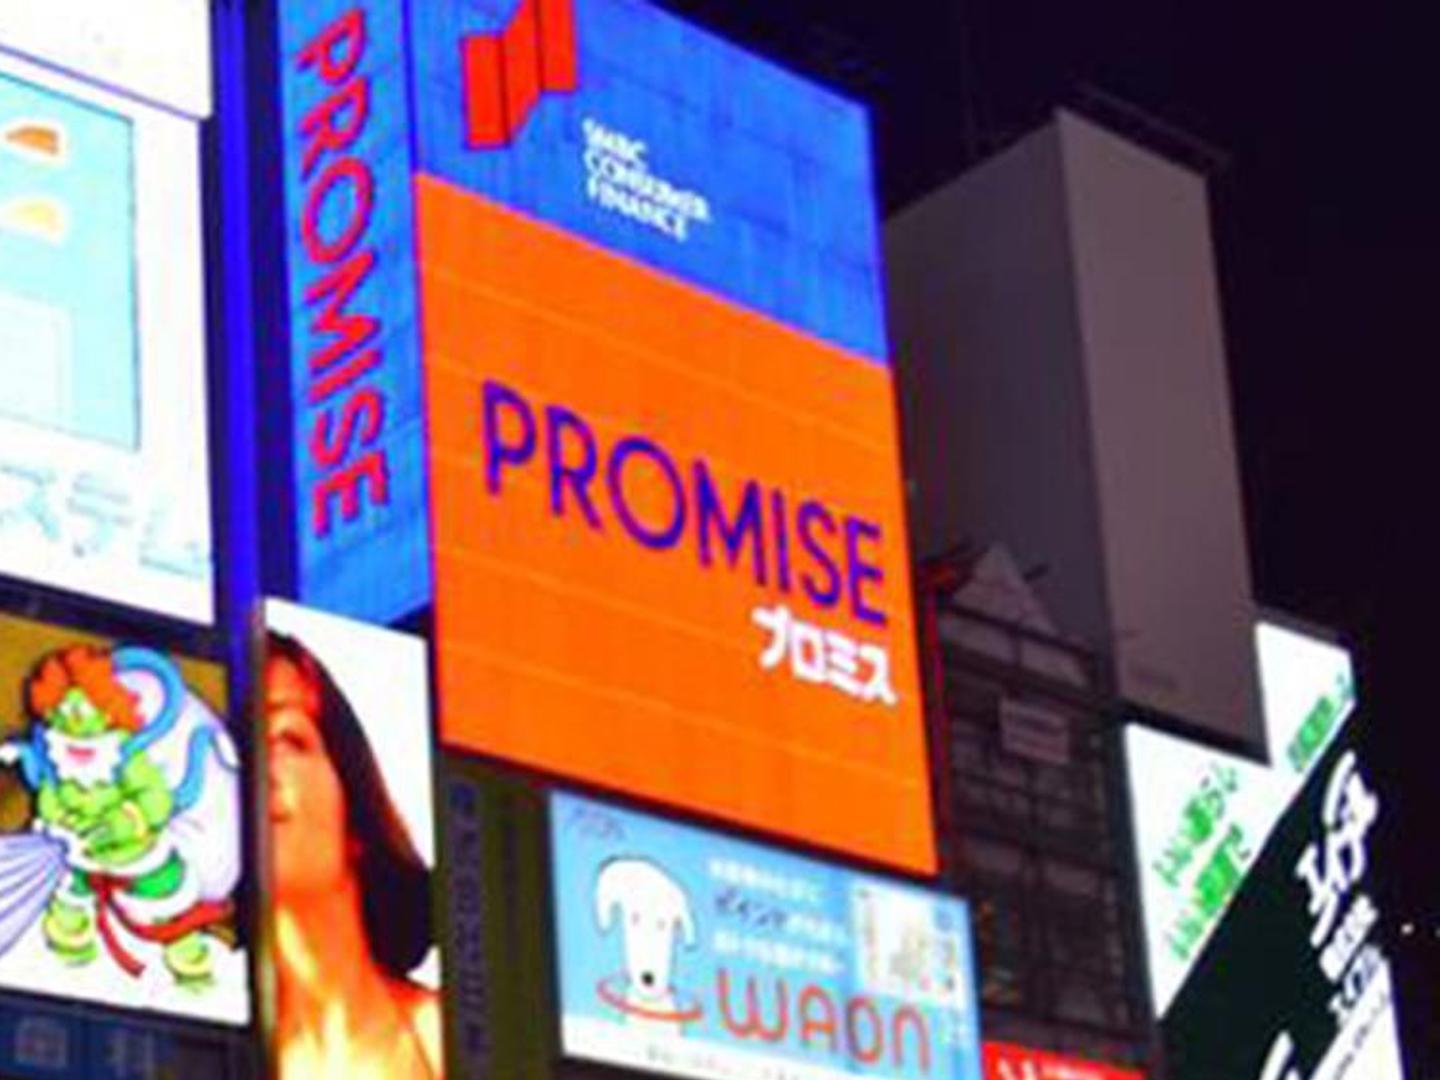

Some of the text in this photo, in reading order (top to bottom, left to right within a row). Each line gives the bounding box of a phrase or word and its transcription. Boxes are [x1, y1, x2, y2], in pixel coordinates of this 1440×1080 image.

[295, 10, 390, 540] PROMISE
[480, 376, 892, 628] PROMISE
[750, 603, 899, 706] プロミス
